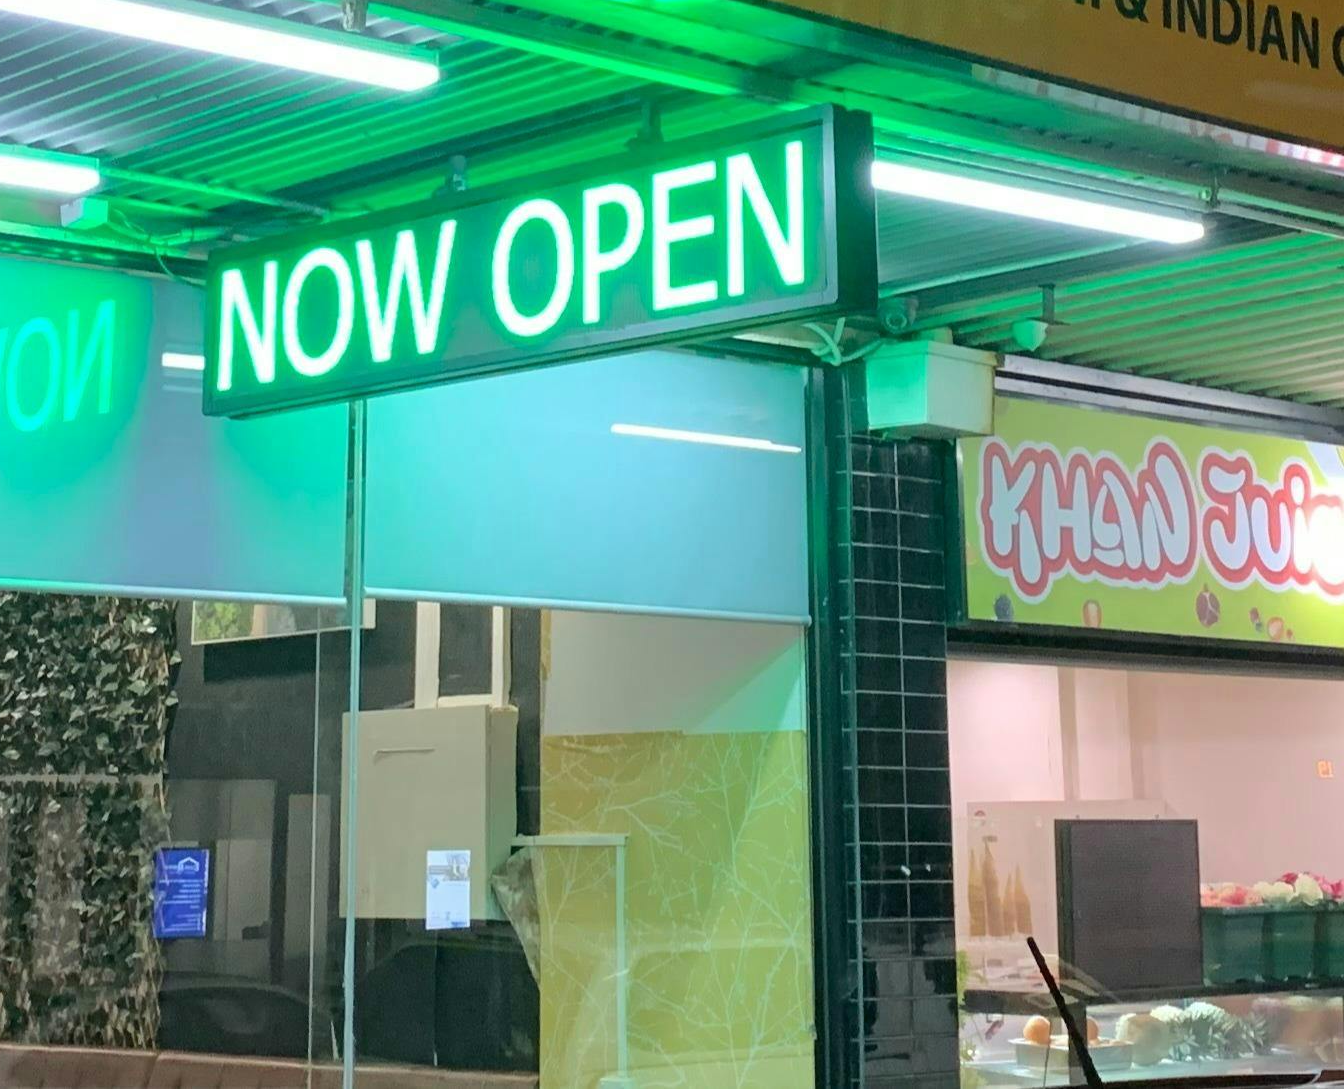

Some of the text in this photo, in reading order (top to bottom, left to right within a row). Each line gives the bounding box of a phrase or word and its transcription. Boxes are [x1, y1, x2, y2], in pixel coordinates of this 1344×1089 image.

[216, 139, 806, 392] NOW OPEN
[982, 439, 1198, 598] KHAN
